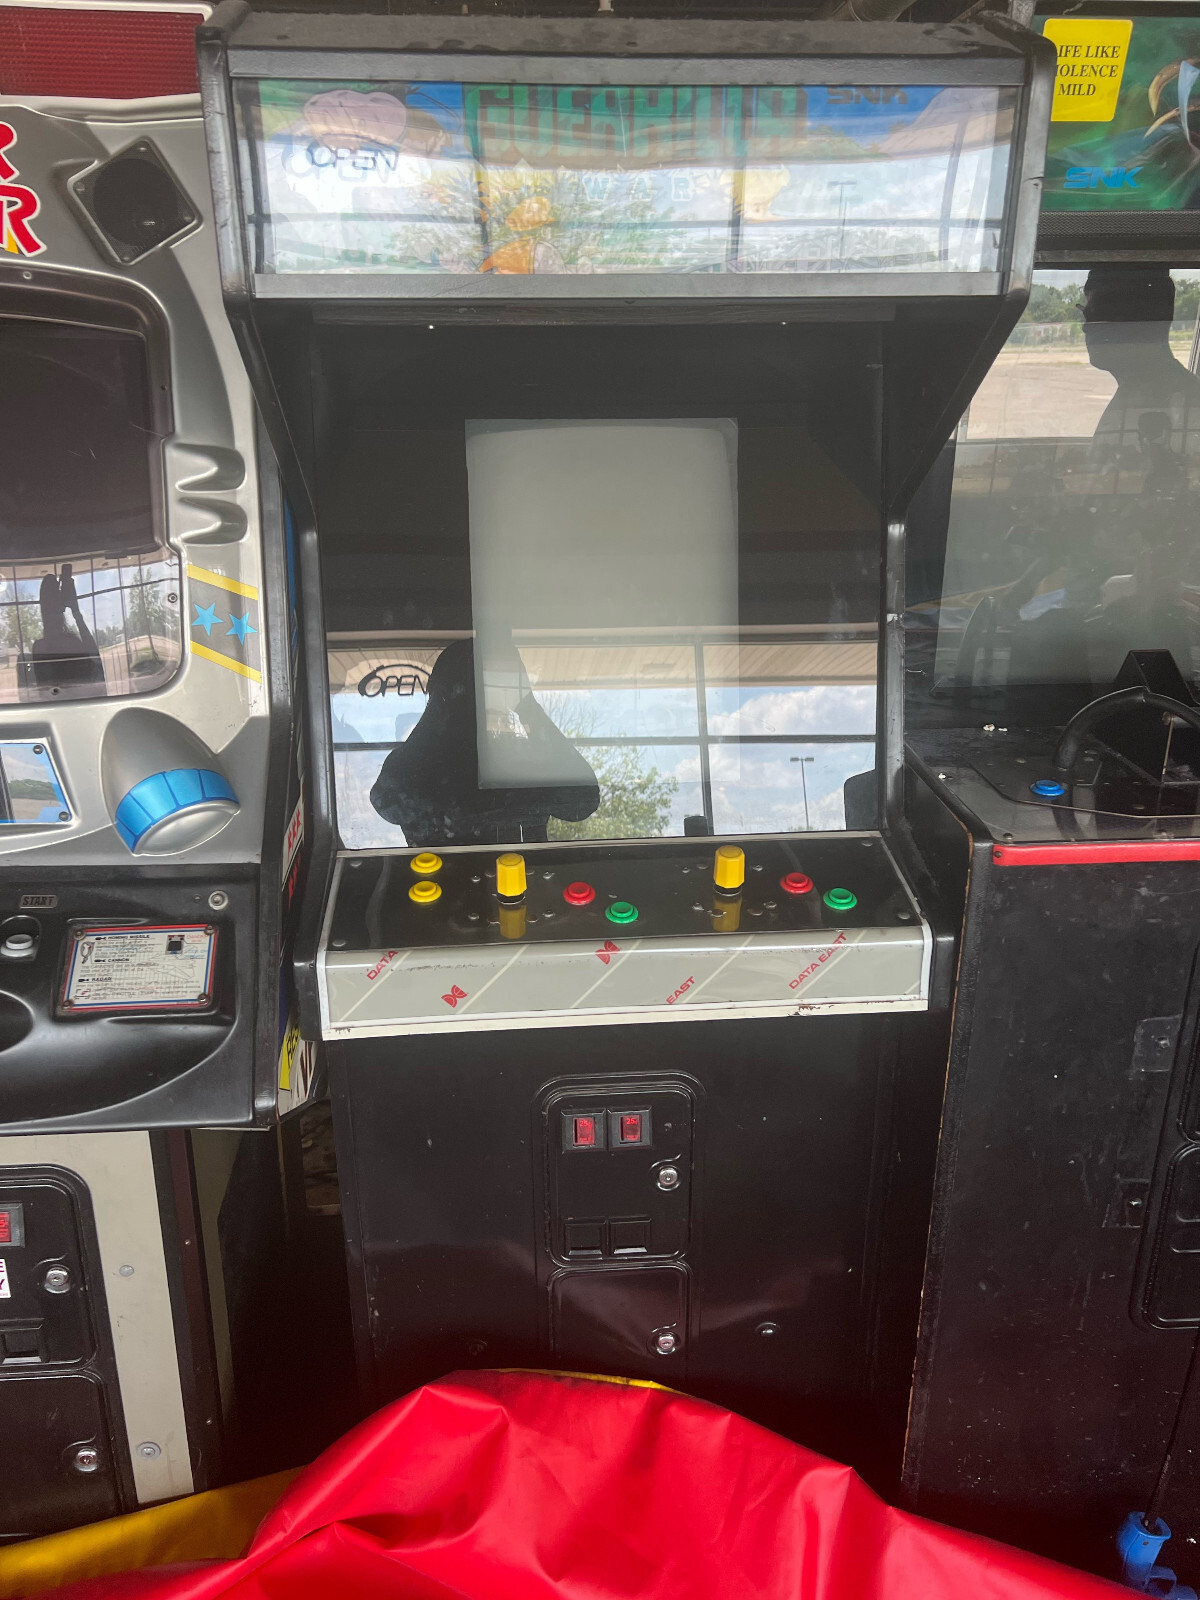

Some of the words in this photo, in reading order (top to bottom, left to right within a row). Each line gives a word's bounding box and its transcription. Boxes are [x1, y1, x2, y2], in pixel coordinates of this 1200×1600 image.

[1057, 45, 1082, 58] IFE
[1085, 45, 1120, 58] LIKE
[827, 85, 908, 105] SNK
[1057, 83, 1096, 96] MILD
[467, 86, 803, 157] GUERRILLA
[1063, 166, 1144, 189] SNK
[22, 896, 55, 906] START
[367, 950, 399, 980] DATA
[790, 962, 820, 990] DATA
[818, 932, 847, 963] EAST
[666, 975, 696, 1005] EAST
